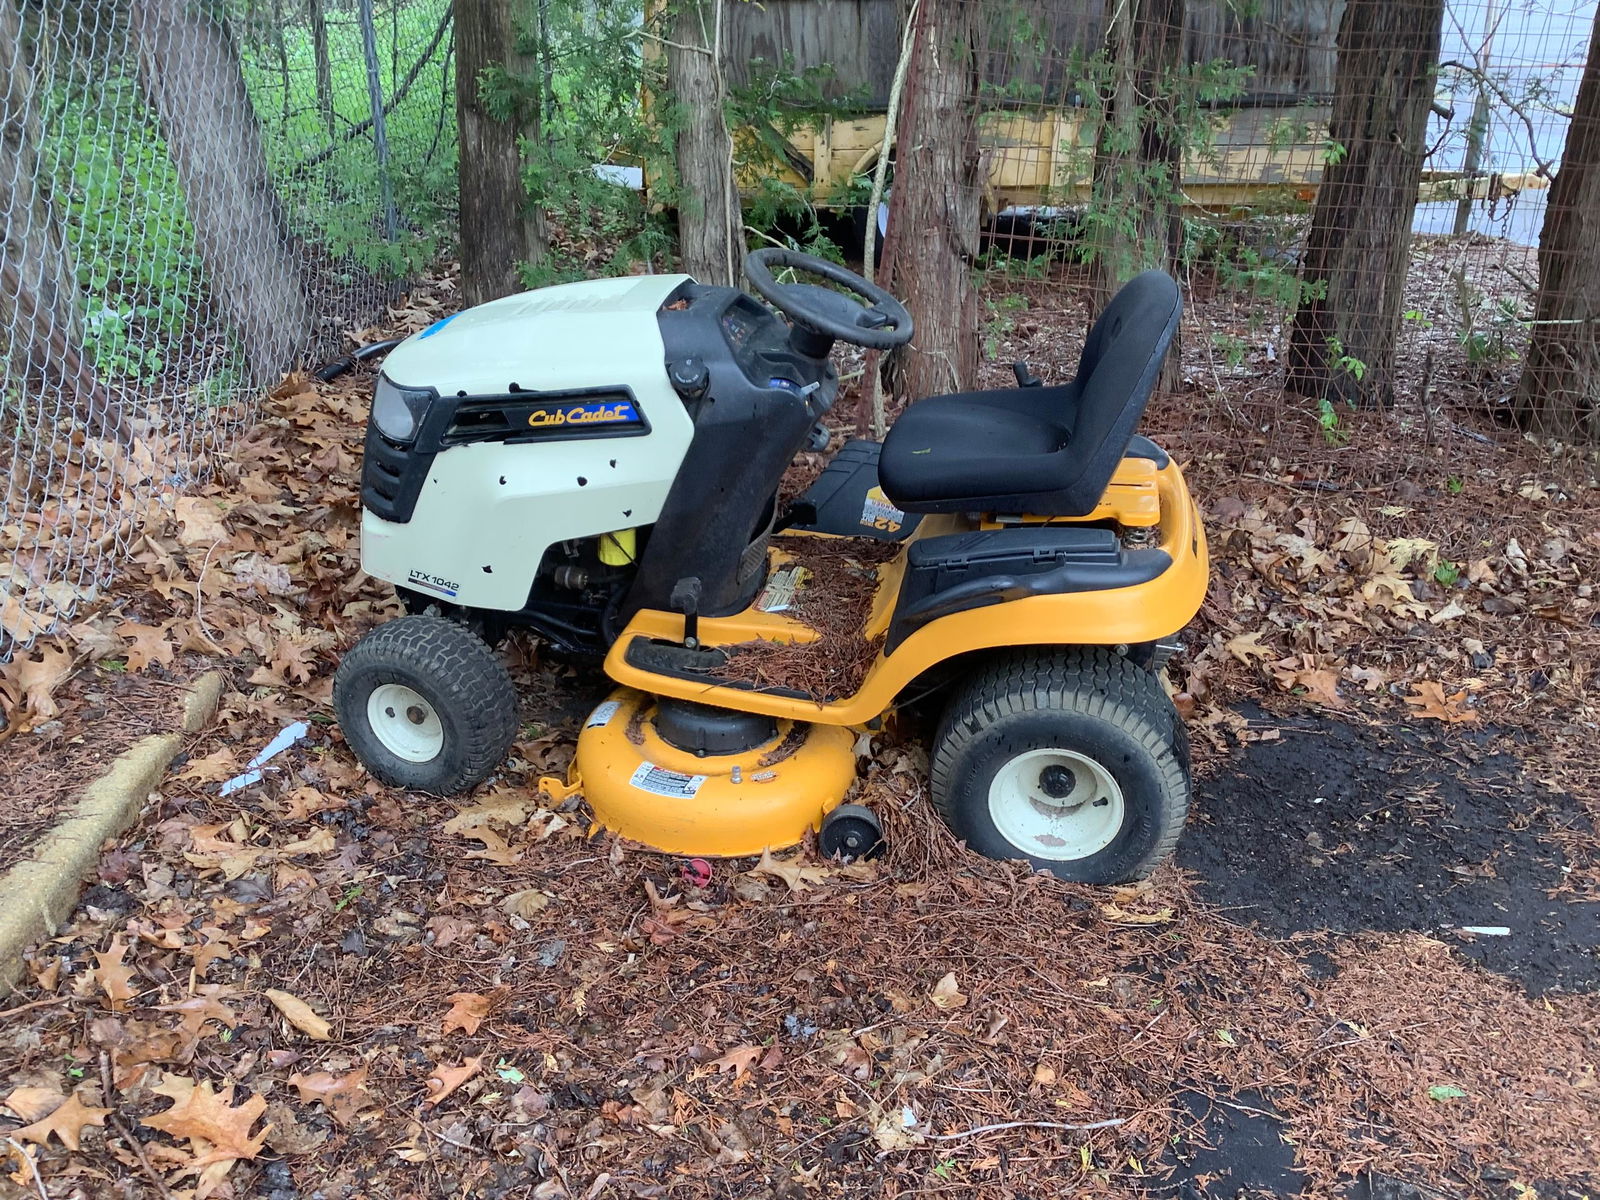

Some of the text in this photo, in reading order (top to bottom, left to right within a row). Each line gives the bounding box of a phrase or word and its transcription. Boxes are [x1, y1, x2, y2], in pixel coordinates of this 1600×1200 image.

[528, 405, 630, 427] Cub Cadet
[874, 516, 901, 532] 42
[409, 569, 431, 582] LTX
[432, 576, 460, 592] 1042
